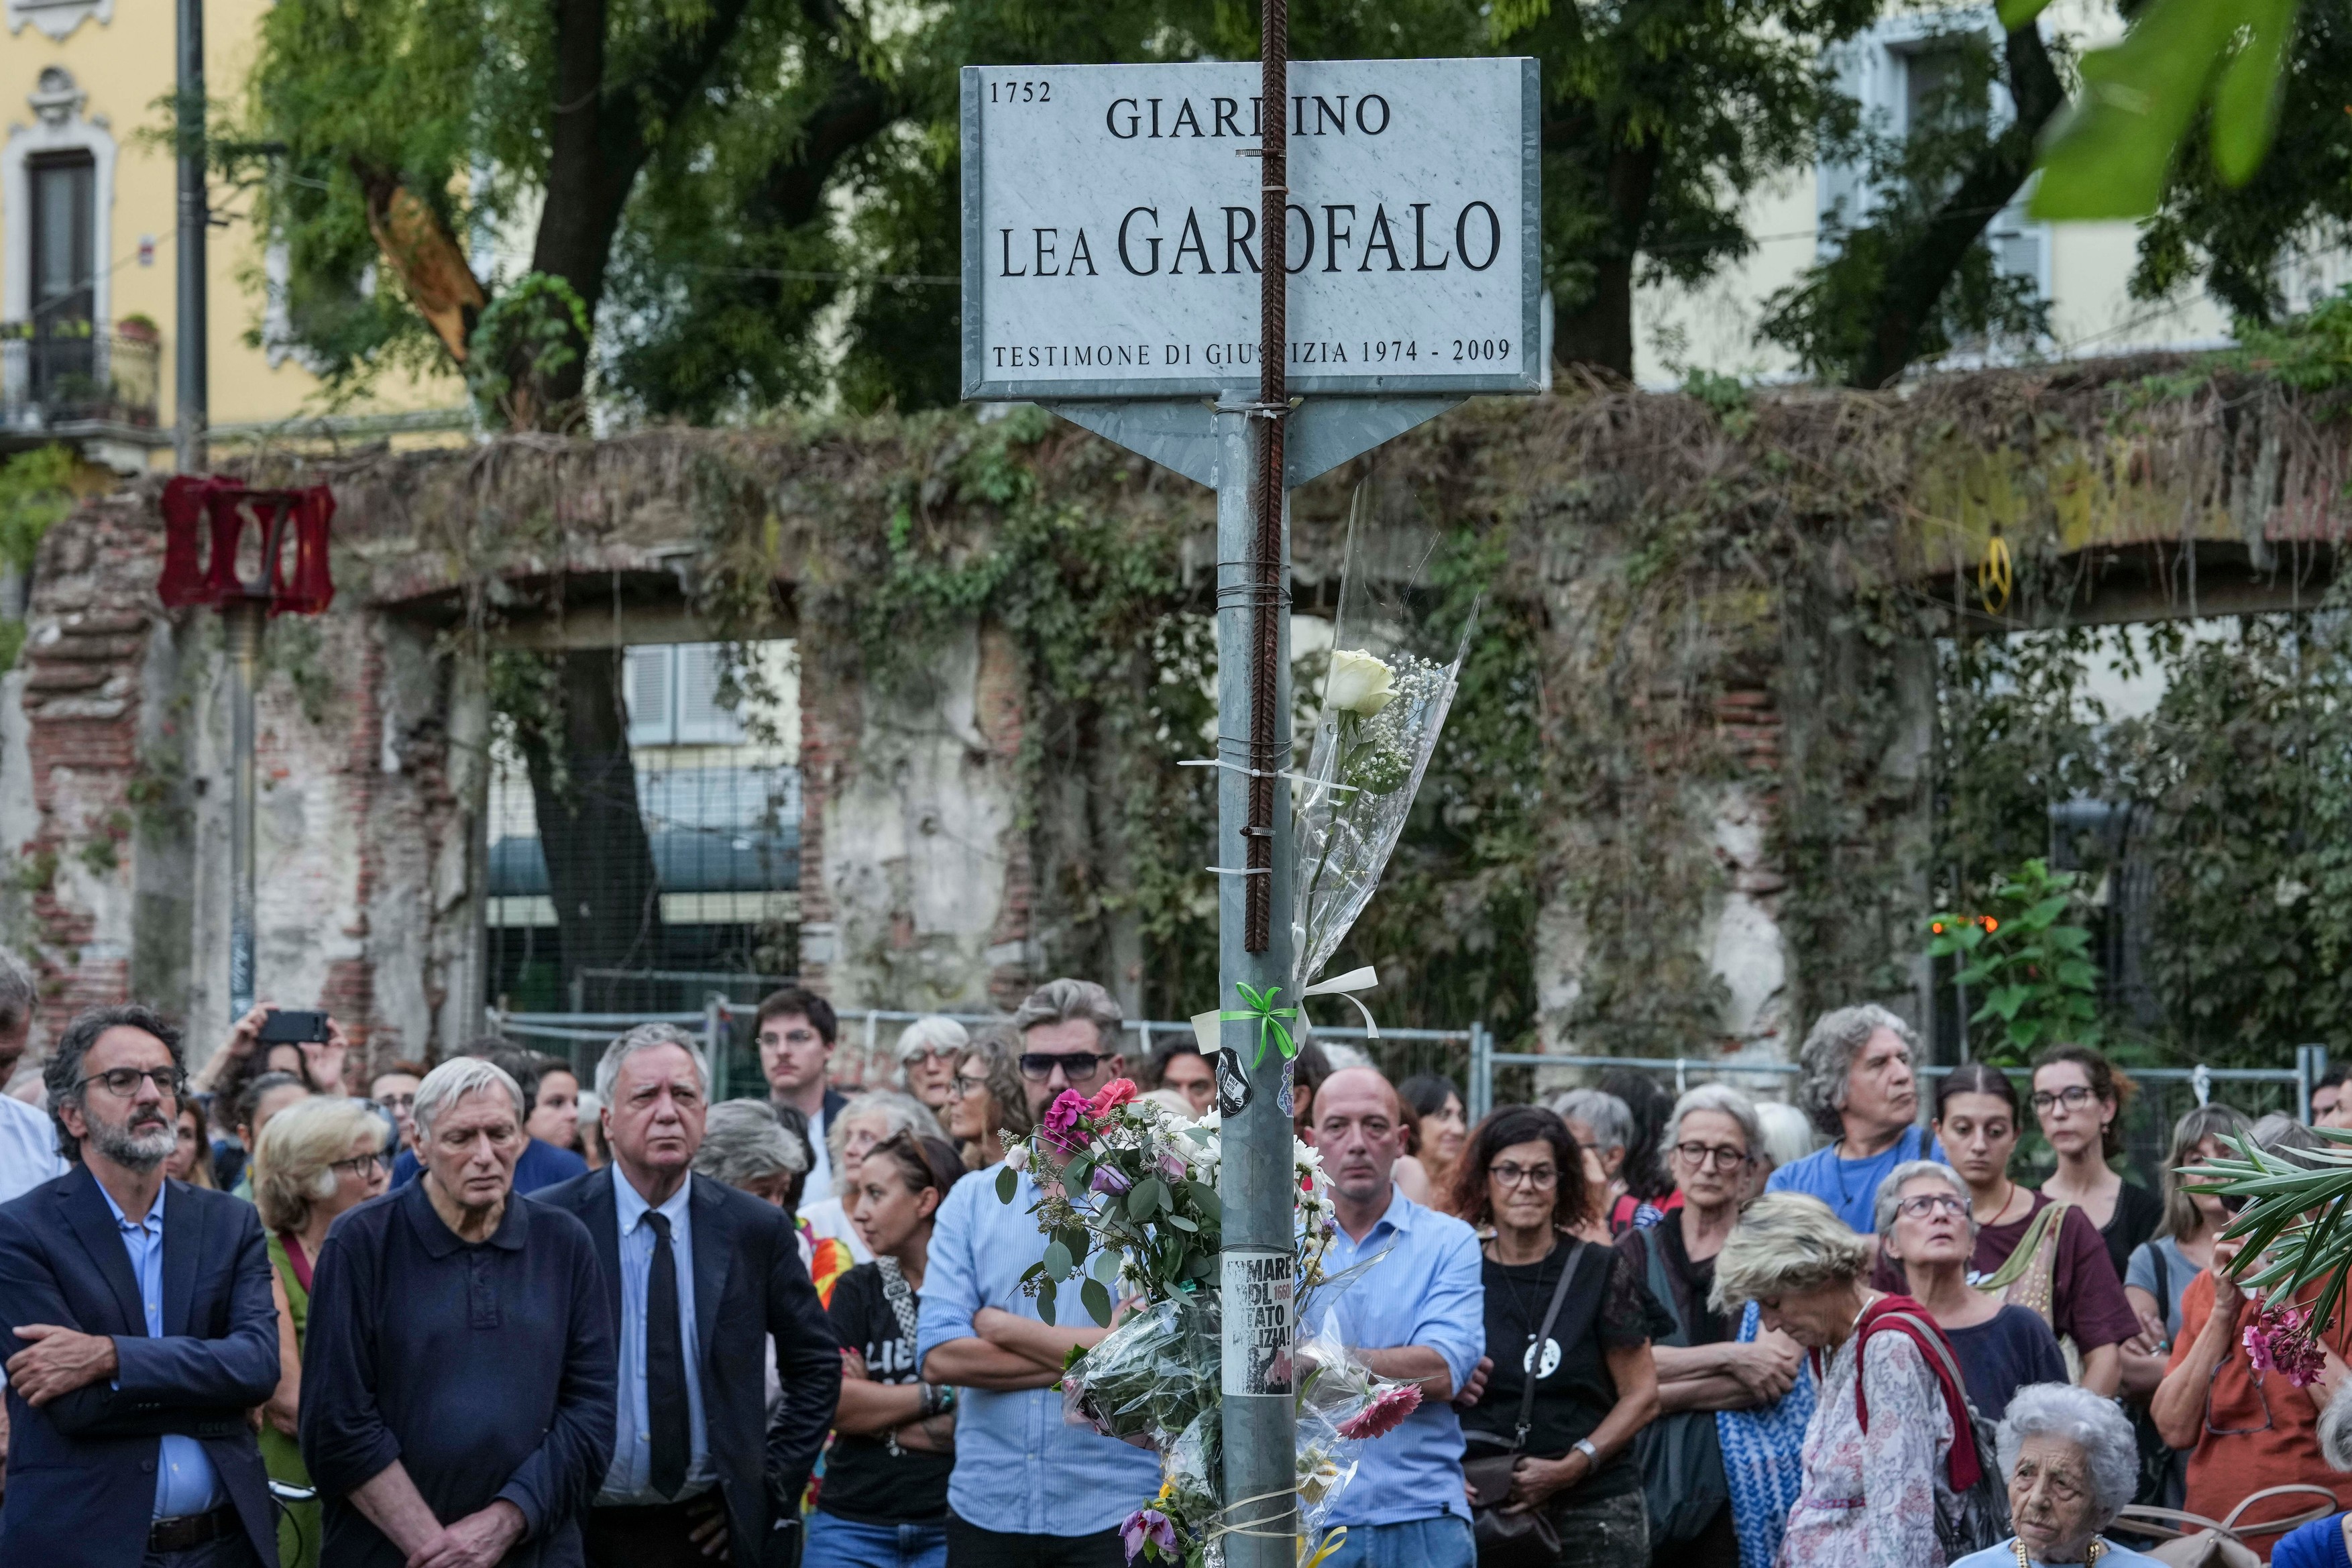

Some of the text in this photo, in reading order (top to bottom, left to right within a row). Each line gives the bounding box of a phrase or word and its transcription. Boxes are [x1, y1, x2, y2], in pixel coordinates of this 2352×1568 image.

[991, 81, 1051, 103] 1752
[999, 201, 1501, 277] LEA GAROFALO
[993, 345, 1150, 368] TESTIMONE
[1165, 344, 1190, 365] DI
[1206, 342, 1348, 365] GIUIZIA
[1363, 340, 1417, 362] 1974
[1453, 339, 1510, 361] 2009
[1226, 1080, 1235, 1092] WITH
[1229, 1076, 1239, 1086] WALK
[1274, 1282, 1292, 1300] 1660!
